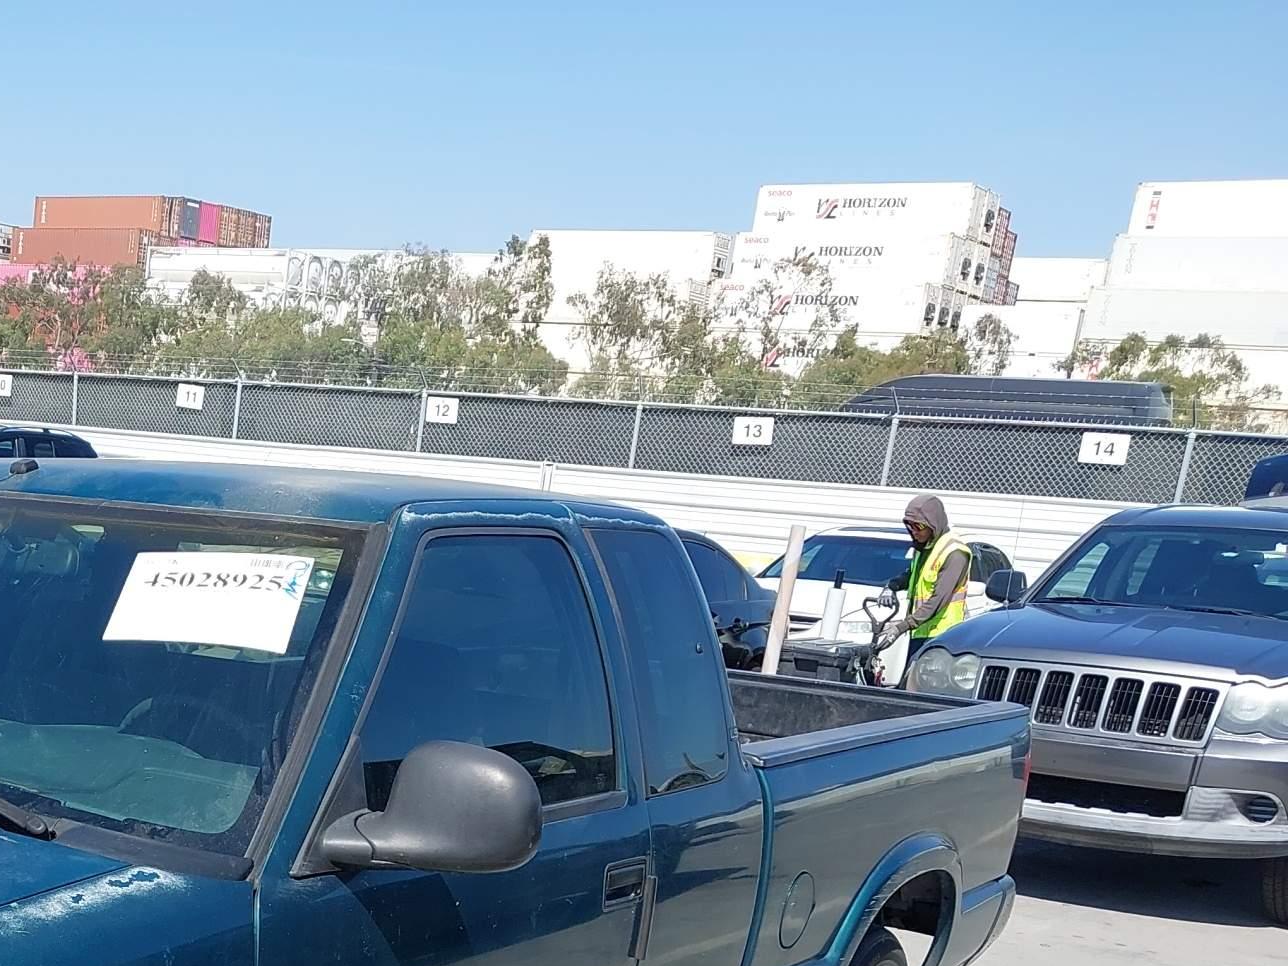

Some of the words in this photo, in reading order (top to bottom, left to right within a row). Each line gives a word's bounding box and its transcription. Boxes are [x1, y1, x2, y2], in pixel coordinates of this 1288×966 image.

[767, 189, 793, 197] seaco
[842, 197, 908, 209] HORIZON
[818, 246, 884, 257] HORIZON
[794, 294, 859, 306] HORIZON
[186, 391, 197, 403] 11
[435, 404, 450, 417] 12
[744, 424, 762, 438] 13
[1093, 441, 1115, 456] 14
[144, 572, 284, 591] 45028925
